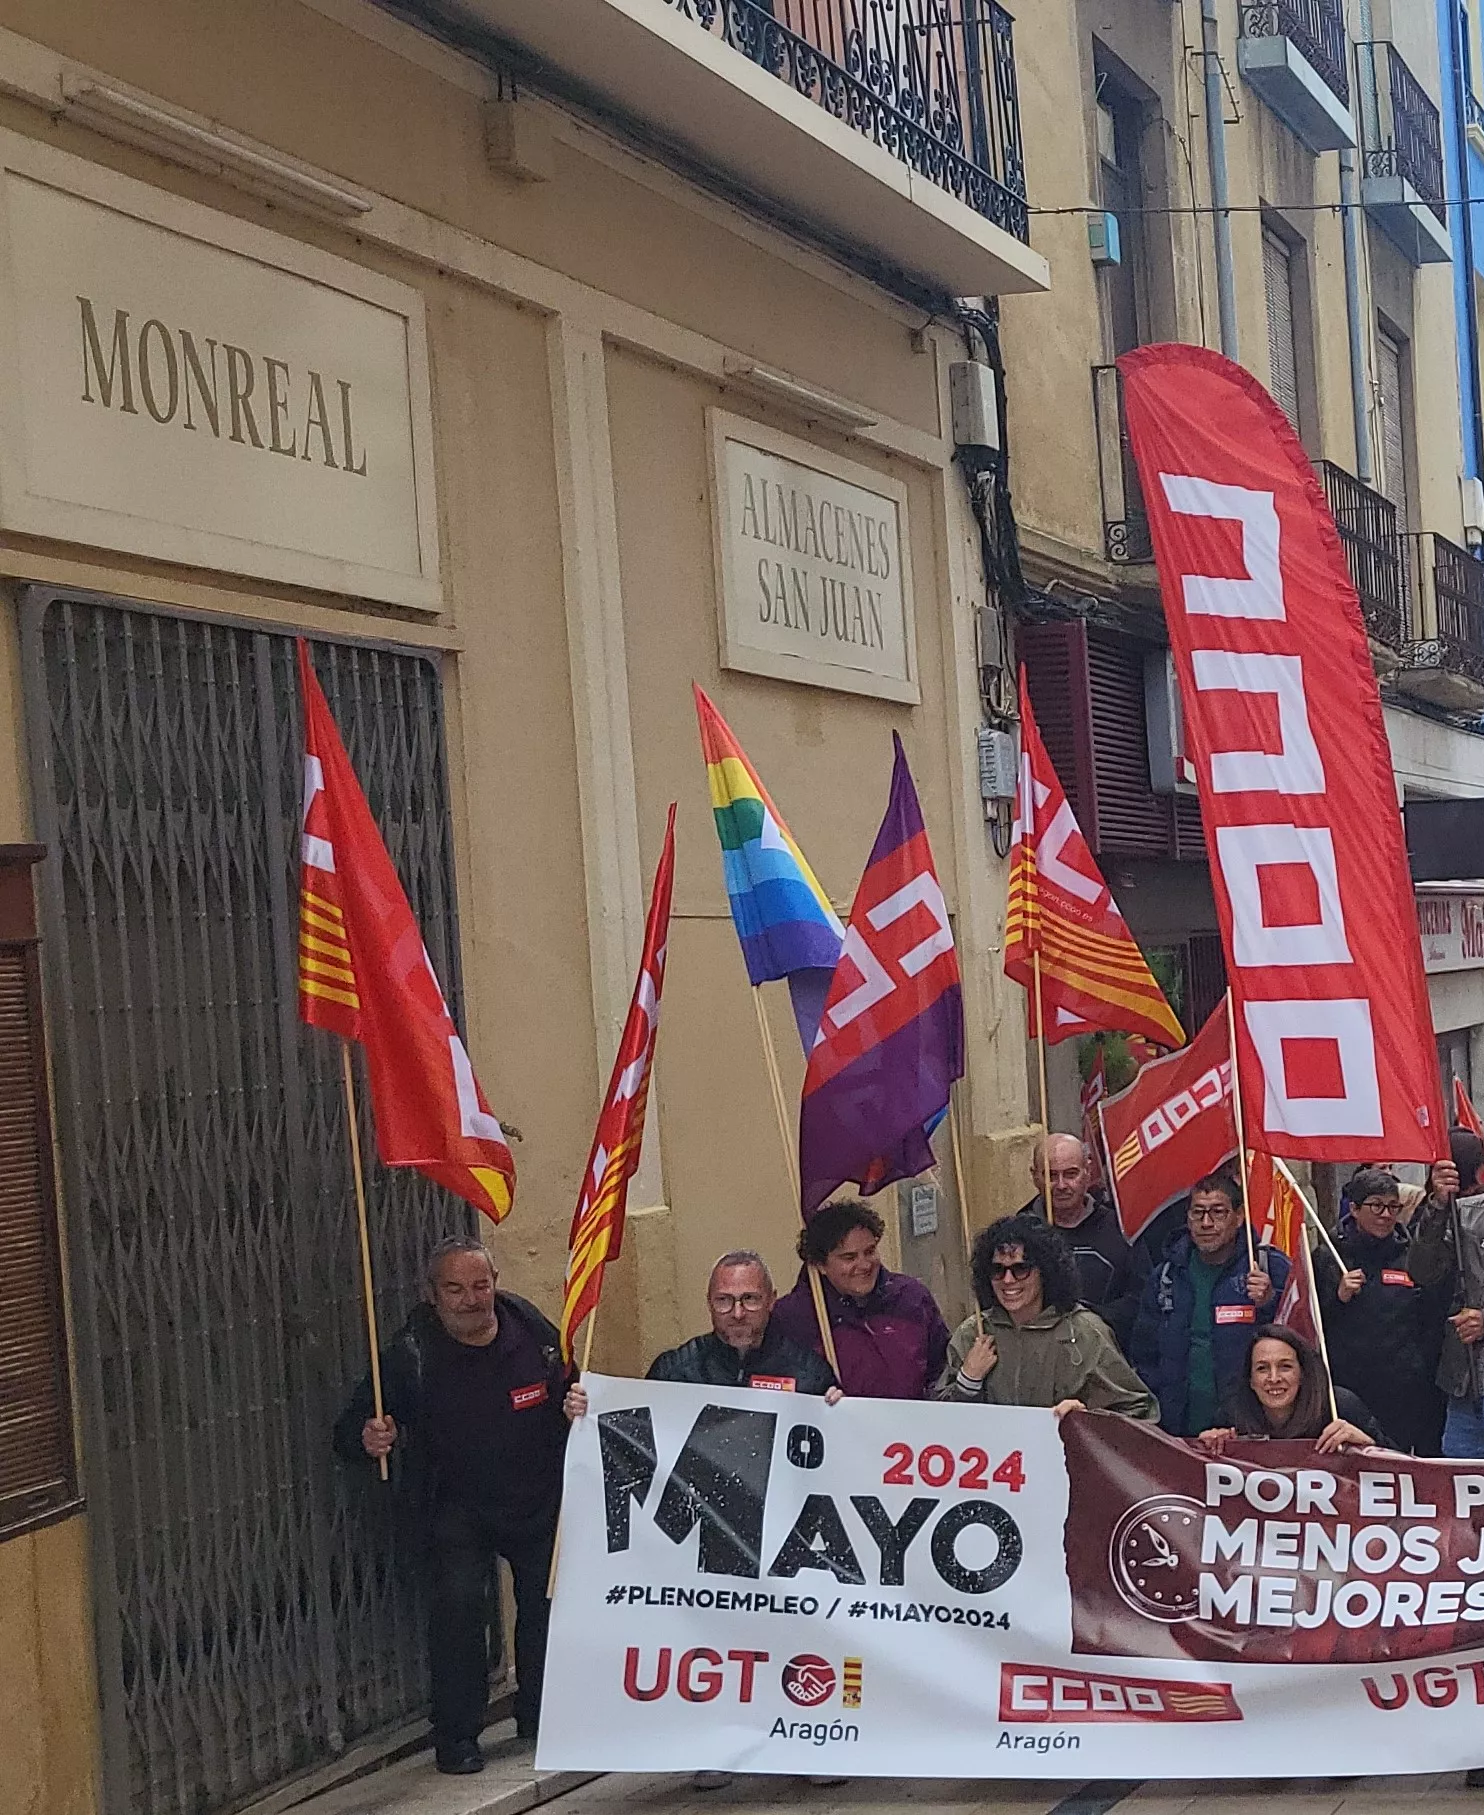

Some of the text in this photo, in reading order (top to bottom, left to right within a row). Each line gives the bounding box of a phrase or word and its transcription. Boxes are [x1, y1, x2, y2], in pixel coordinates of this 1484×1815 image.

[76, 296, 367, 476] MONREAL
[741, 473, 890, 580] ALMACENES
[758, 558, 883, 650] SAN JUAN
[514, 1389, 541, 1403] CCOO
[752, 1380, 782, 1391] CCOO
[882, 1442, 1027, 1493] 2024
[1205, 1463, 1339, 1516] POR
[1359, 1471, 1437, 1518] EL
[1201, 1515, 1441, 1575] MENOS
[605, 1585, 819, 1618] #PLENOEMPLEO
[847, 1599, 1011, 1631] #1MAYO2024
[623, 1646, 770, 1703] UGT
[1011, 1674, 1165, 1712] CCOO
[769, 1716, 860, 1746] Aragón
[996, 1731, 1081, 1755] Aragón
